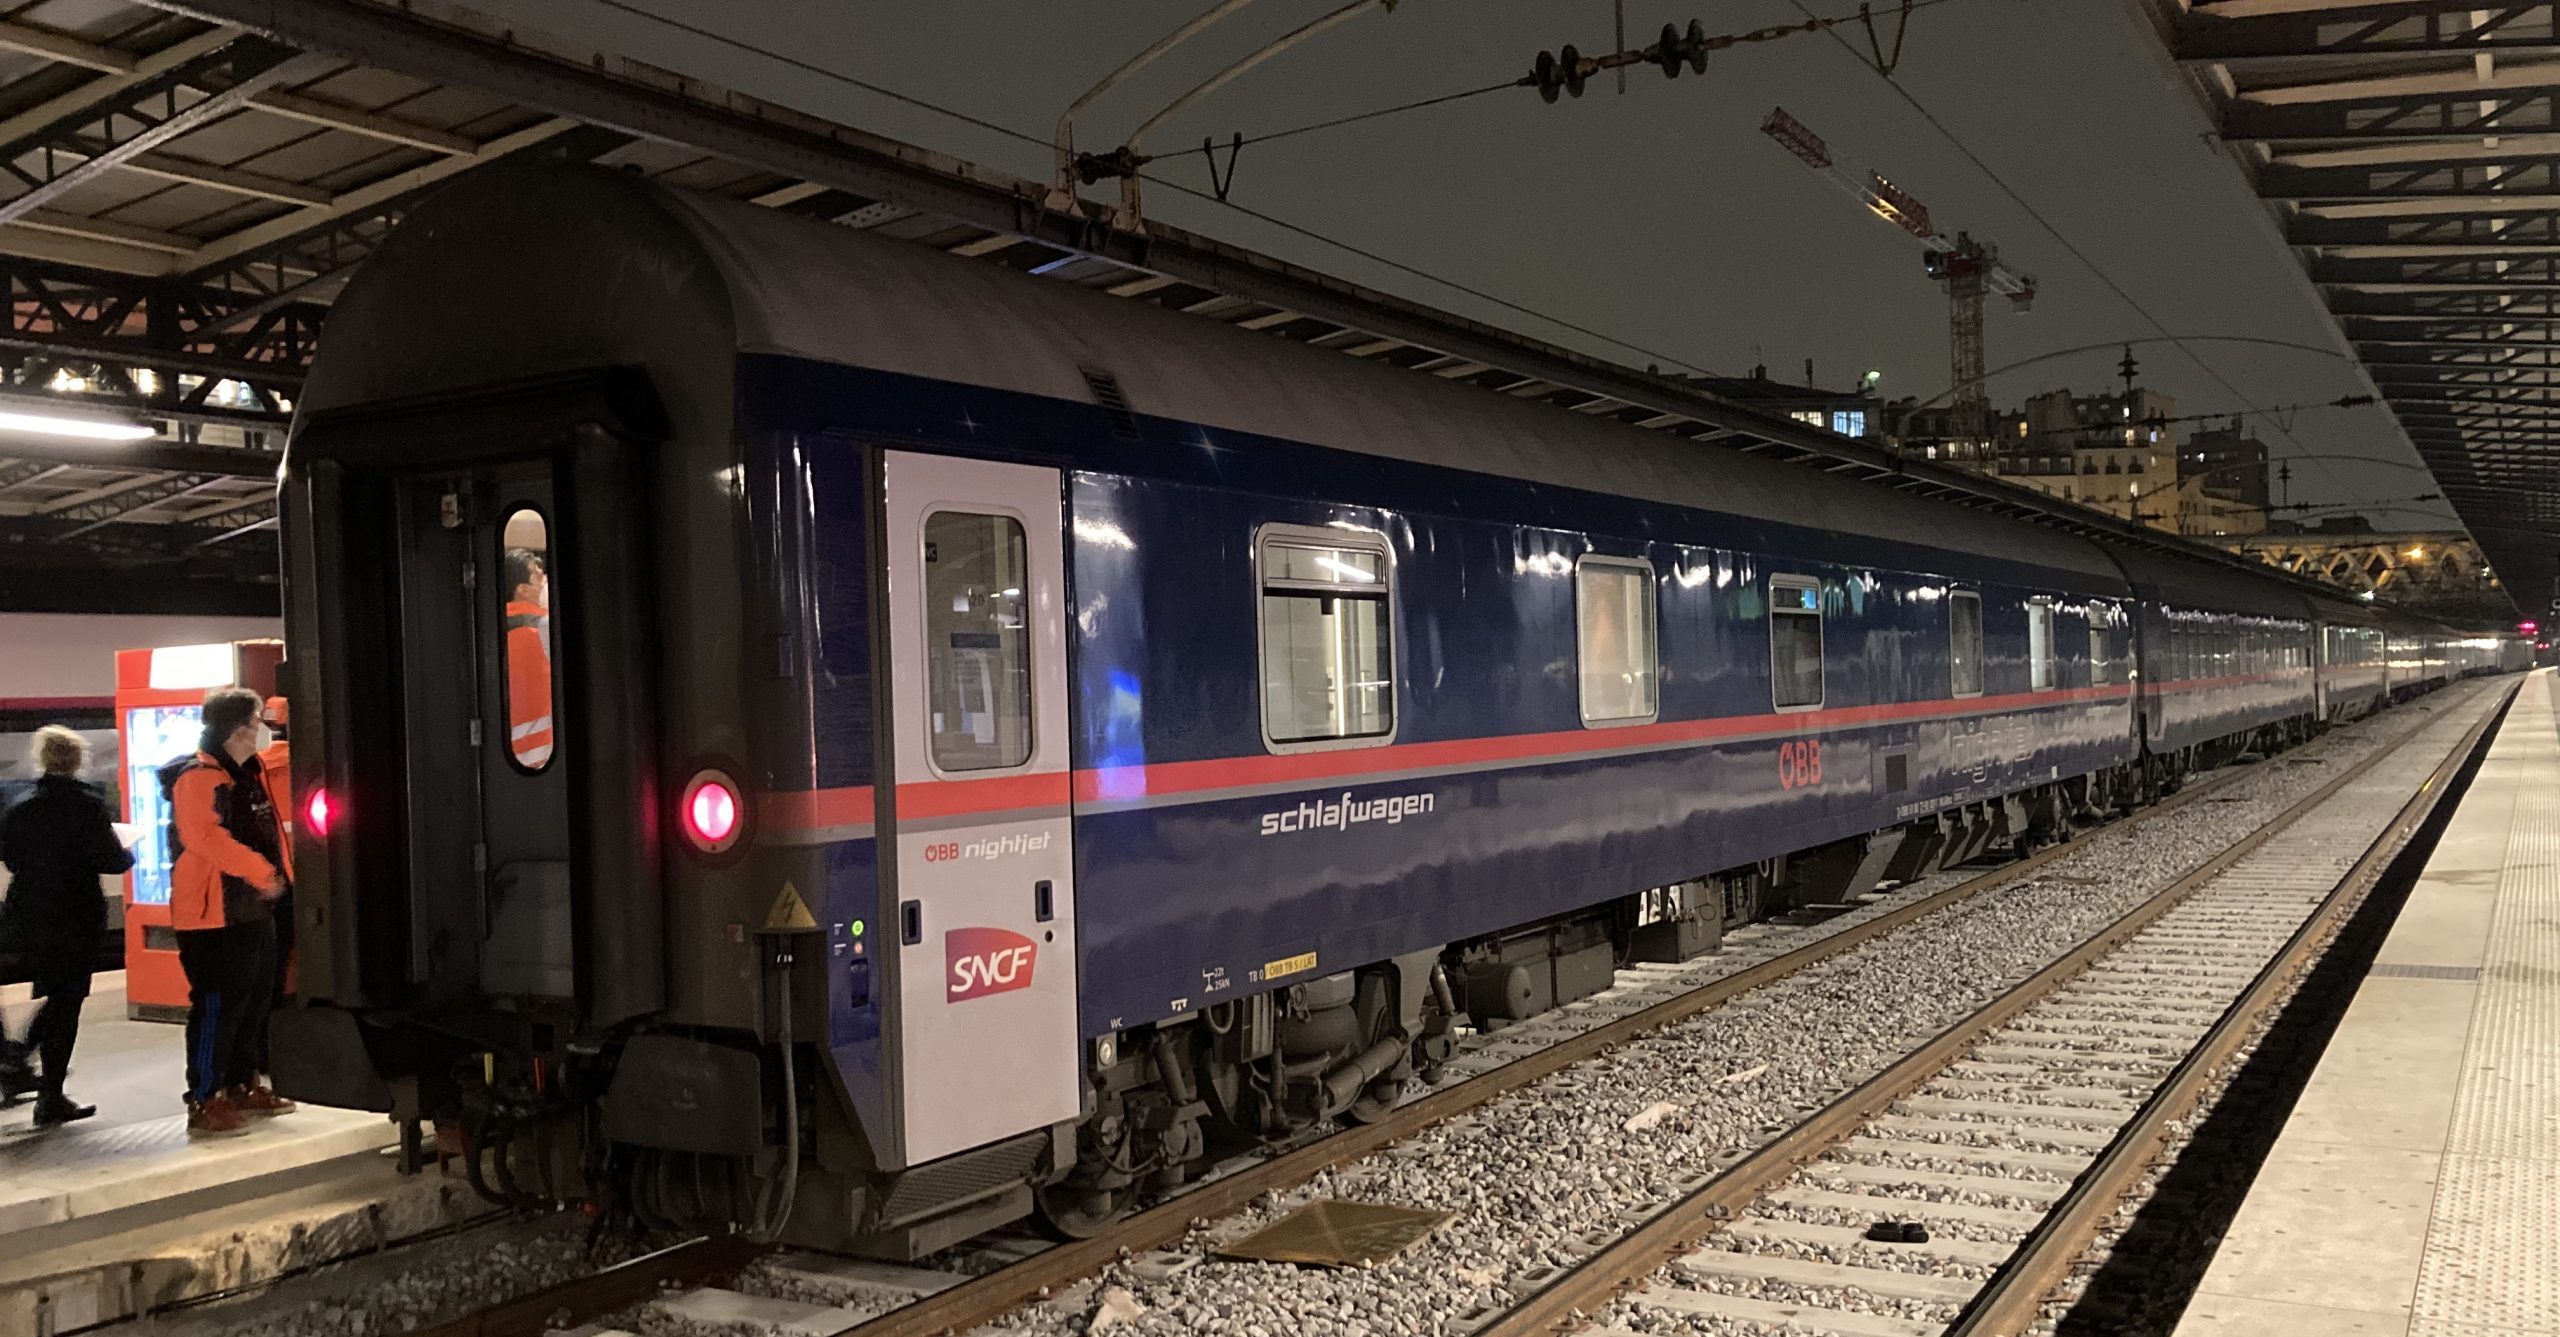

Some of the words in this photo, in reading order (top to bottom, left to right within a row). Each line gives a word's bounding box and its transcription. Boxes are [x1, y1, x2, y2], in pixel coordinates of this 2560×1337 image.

[1779, 739, 1821, 792] ÖBB
[1261, 792, 1434, 836] schlafwagen
[925, 842, 960, 862] ÖBB
[964, 831, 1052, 860] nightjet
[950, 945, 1032, 993] SNCF
[1110, 1016, 1123, 1029] WC
